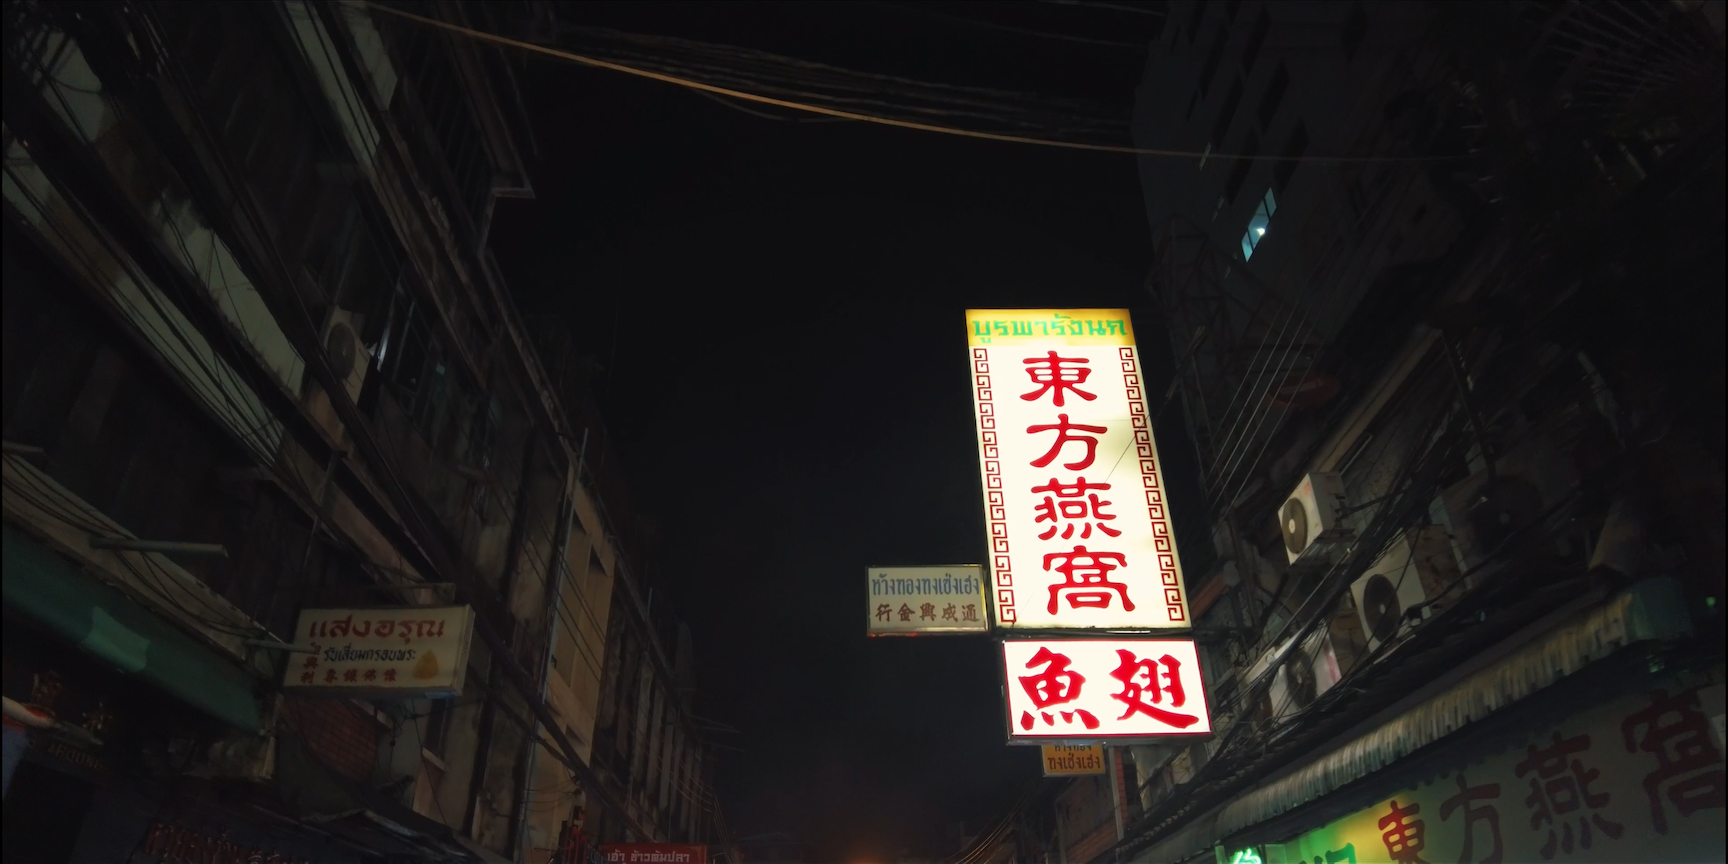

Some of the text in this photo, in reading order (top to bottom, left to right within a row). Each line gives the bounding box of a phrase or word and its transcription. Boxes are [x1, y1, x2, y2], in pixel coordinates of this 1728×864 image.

[972, 313, 1129, 344] บูรพารังนก
[1019, 350, 1136, 616] 東方燕窩
[309, 614, 446, 645] แสงอรุณ
[1017, 646, 1200, 731] 魚翅
